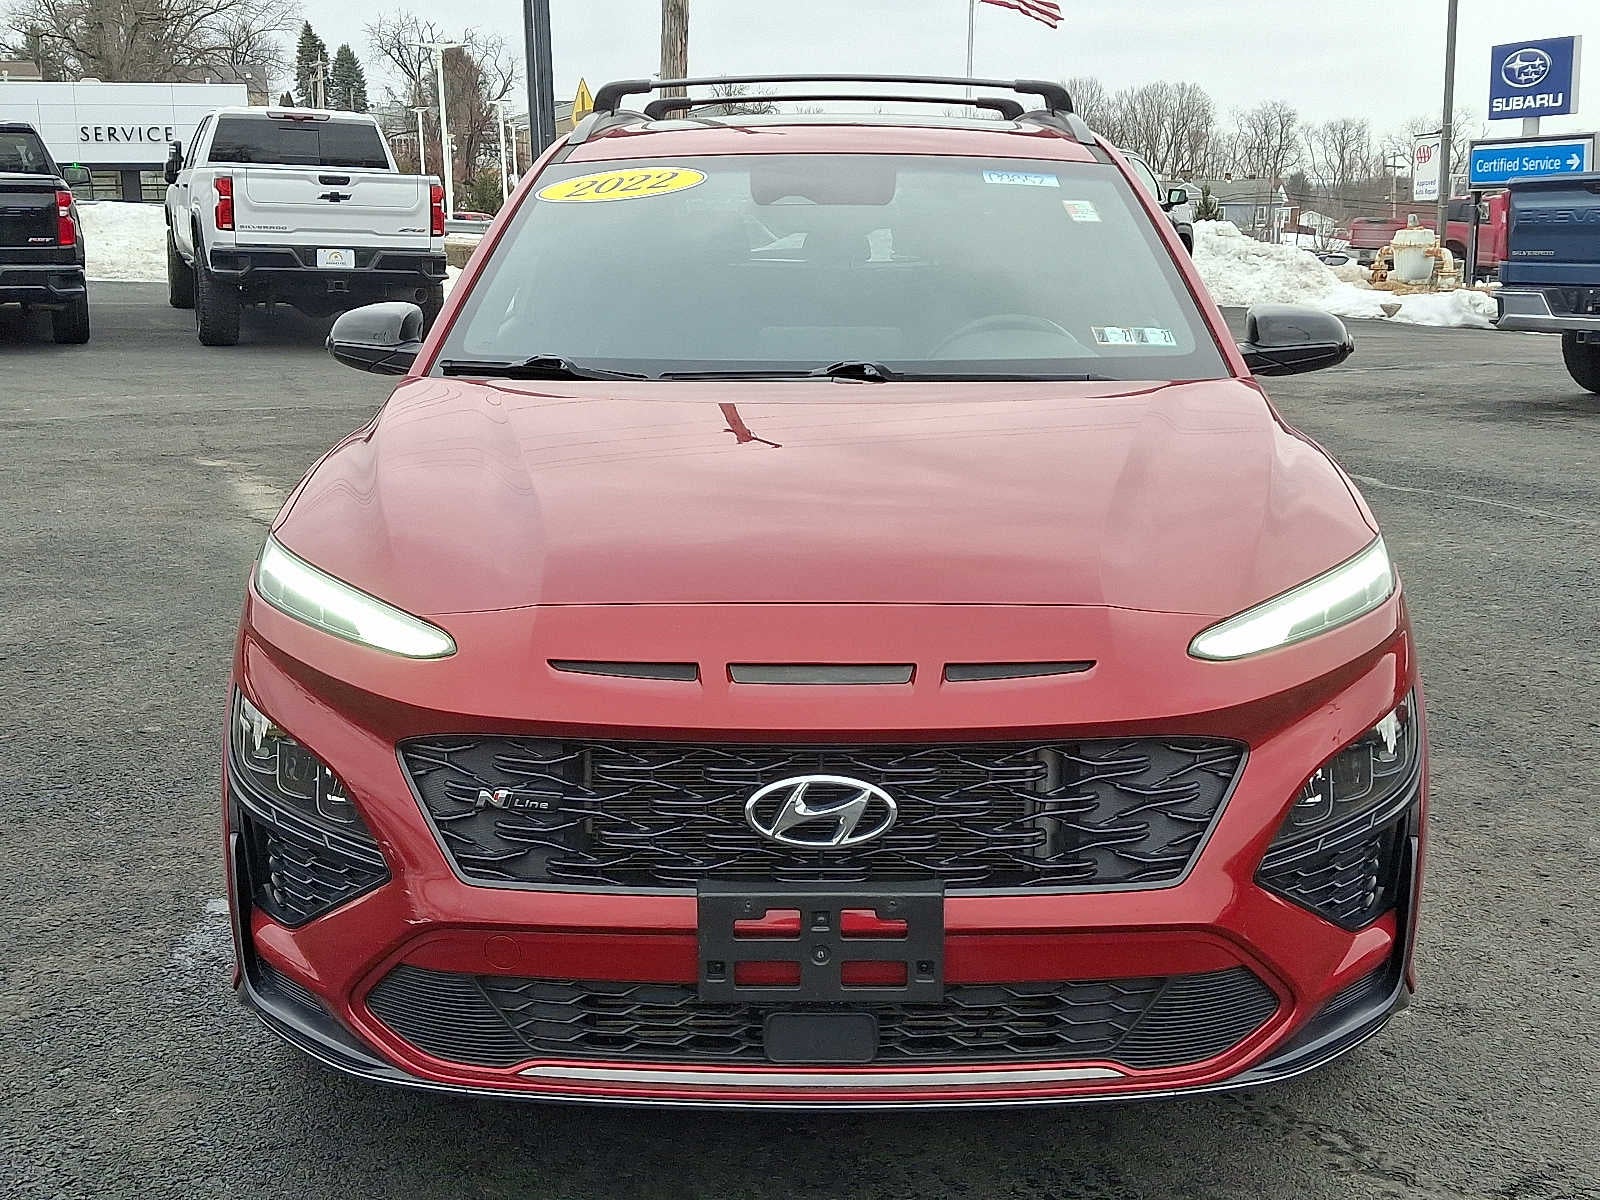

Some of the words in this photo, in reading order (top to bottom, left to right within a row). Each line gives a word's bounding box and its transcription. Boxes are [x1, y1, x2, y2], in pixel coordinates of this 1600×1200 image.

[1493, 93, 1564, 112] SUBARU
[80, 126, 173, 142] SERVICE
[1476, 157, 1520, 173] Certified
[1522, 155, 1561, 171] Service
[564, 172, 679, 197] 2022
[513, 798, 549, 809] Line
